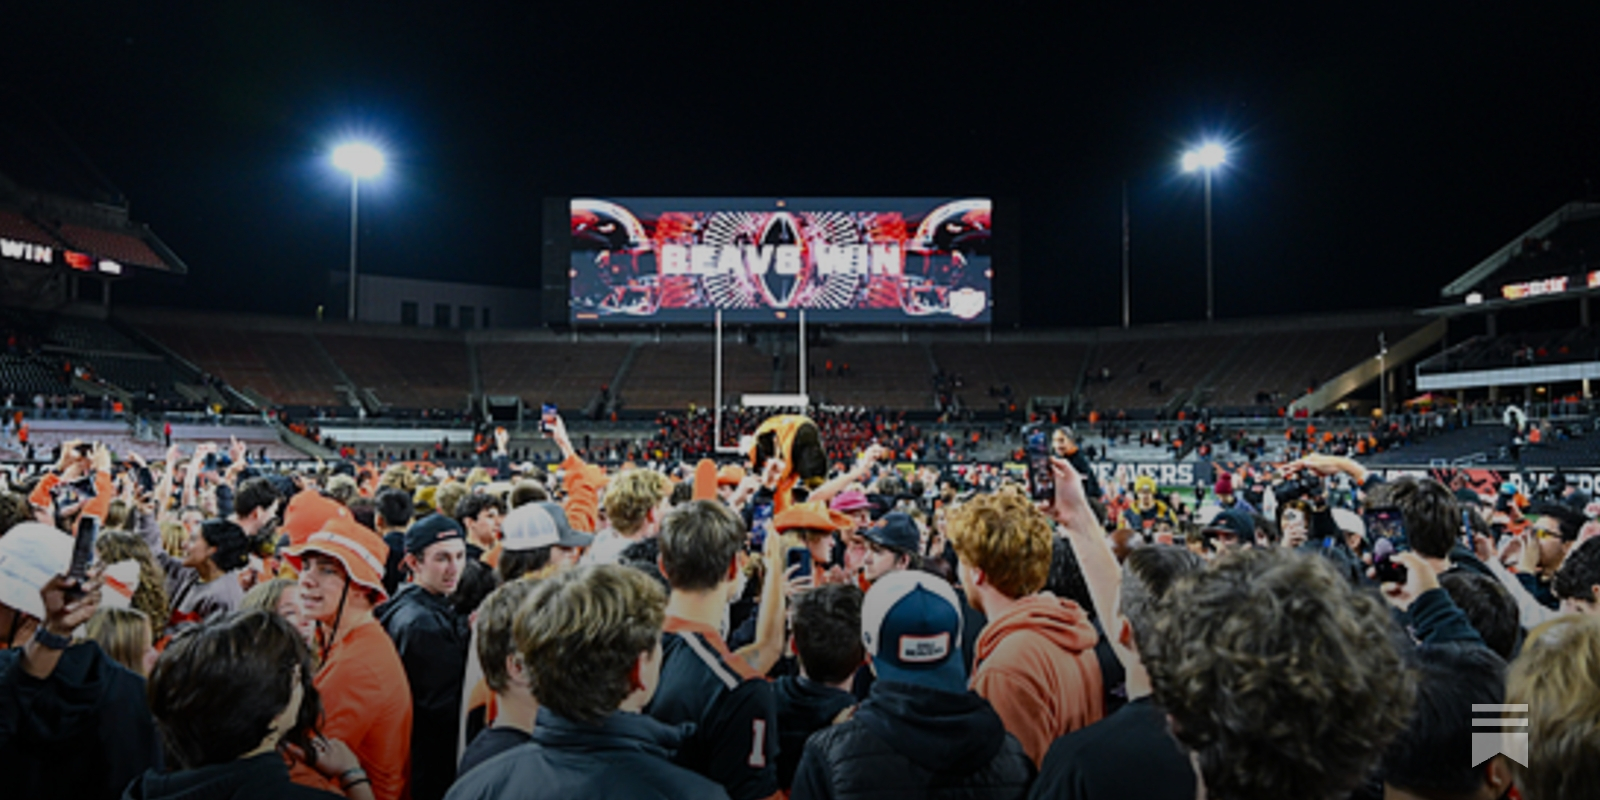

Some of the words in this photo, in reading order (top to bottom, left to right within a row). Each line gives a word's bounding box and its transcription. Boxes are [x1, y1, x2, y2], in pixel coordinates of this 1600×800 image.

[1, 239, 53, 264] WIN
[815, 244, 901, 275] WIN
[748, 719, 766, 767] 1
